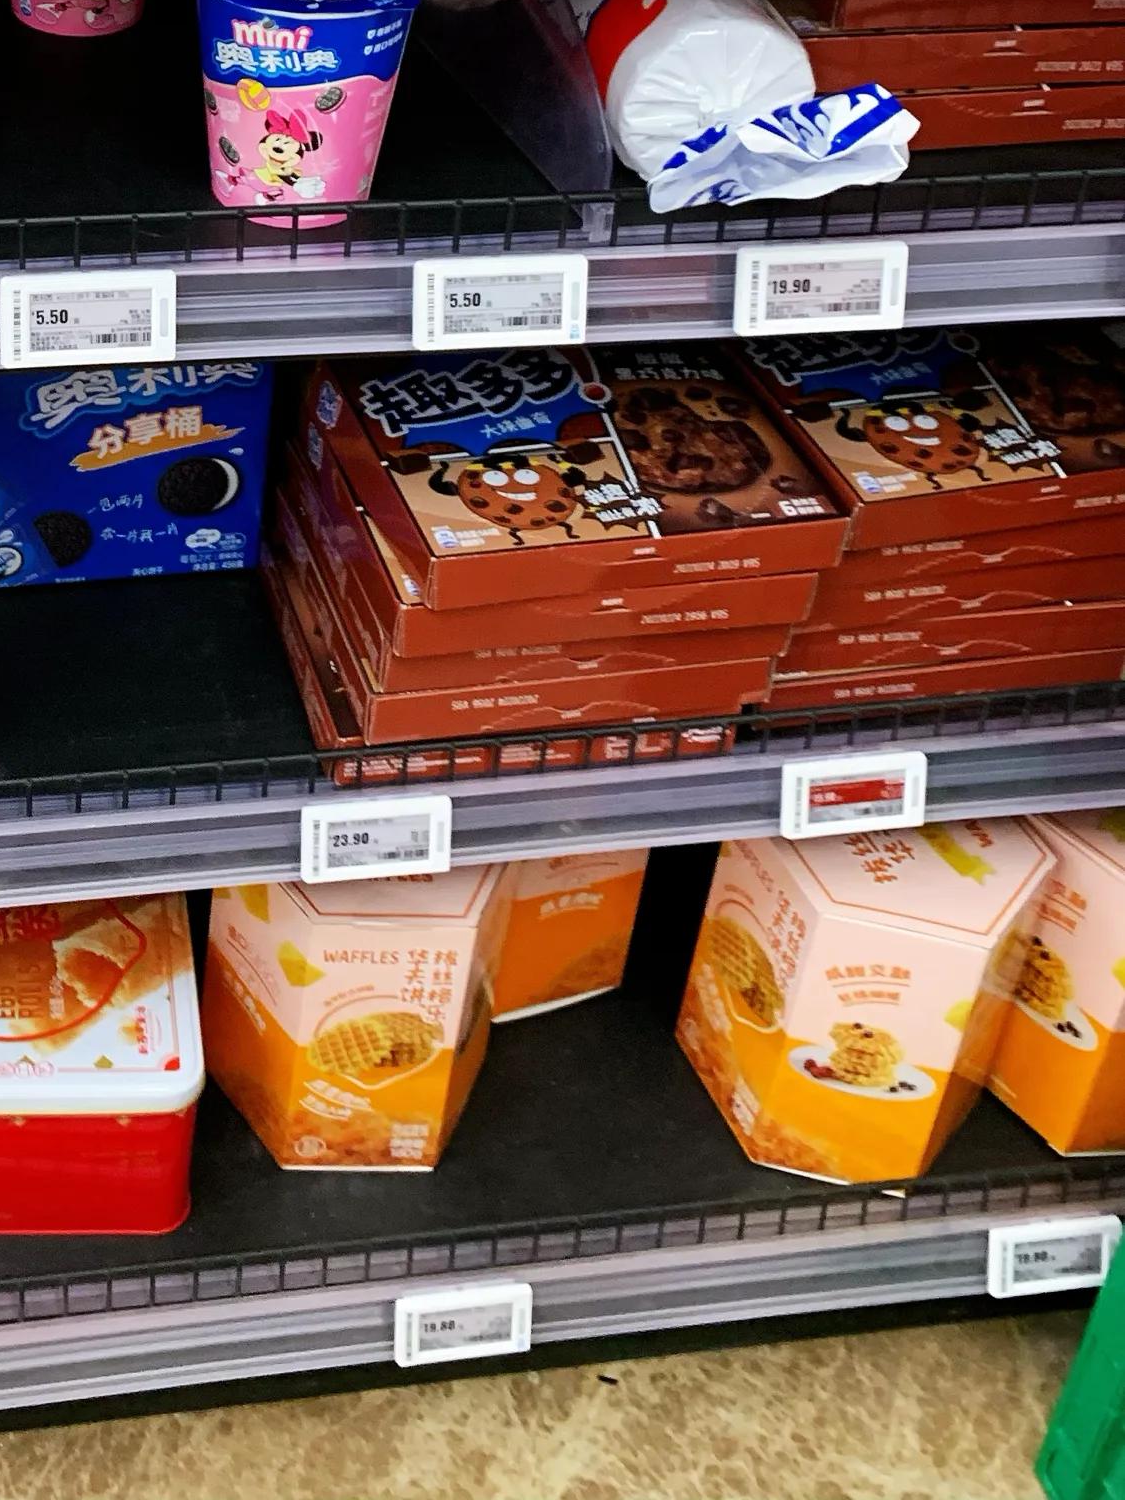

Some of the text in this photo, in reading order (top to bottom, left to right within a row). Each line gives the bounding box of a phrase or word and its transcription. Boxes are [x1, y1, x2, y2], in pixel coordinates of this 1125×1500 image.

[231, 17, 314, 51] mini
[215, 41, 339, 74] 奥利奥
[87, 404, 205, 460] 分享桶
[322, 949, 401, 967] WAFFLES
